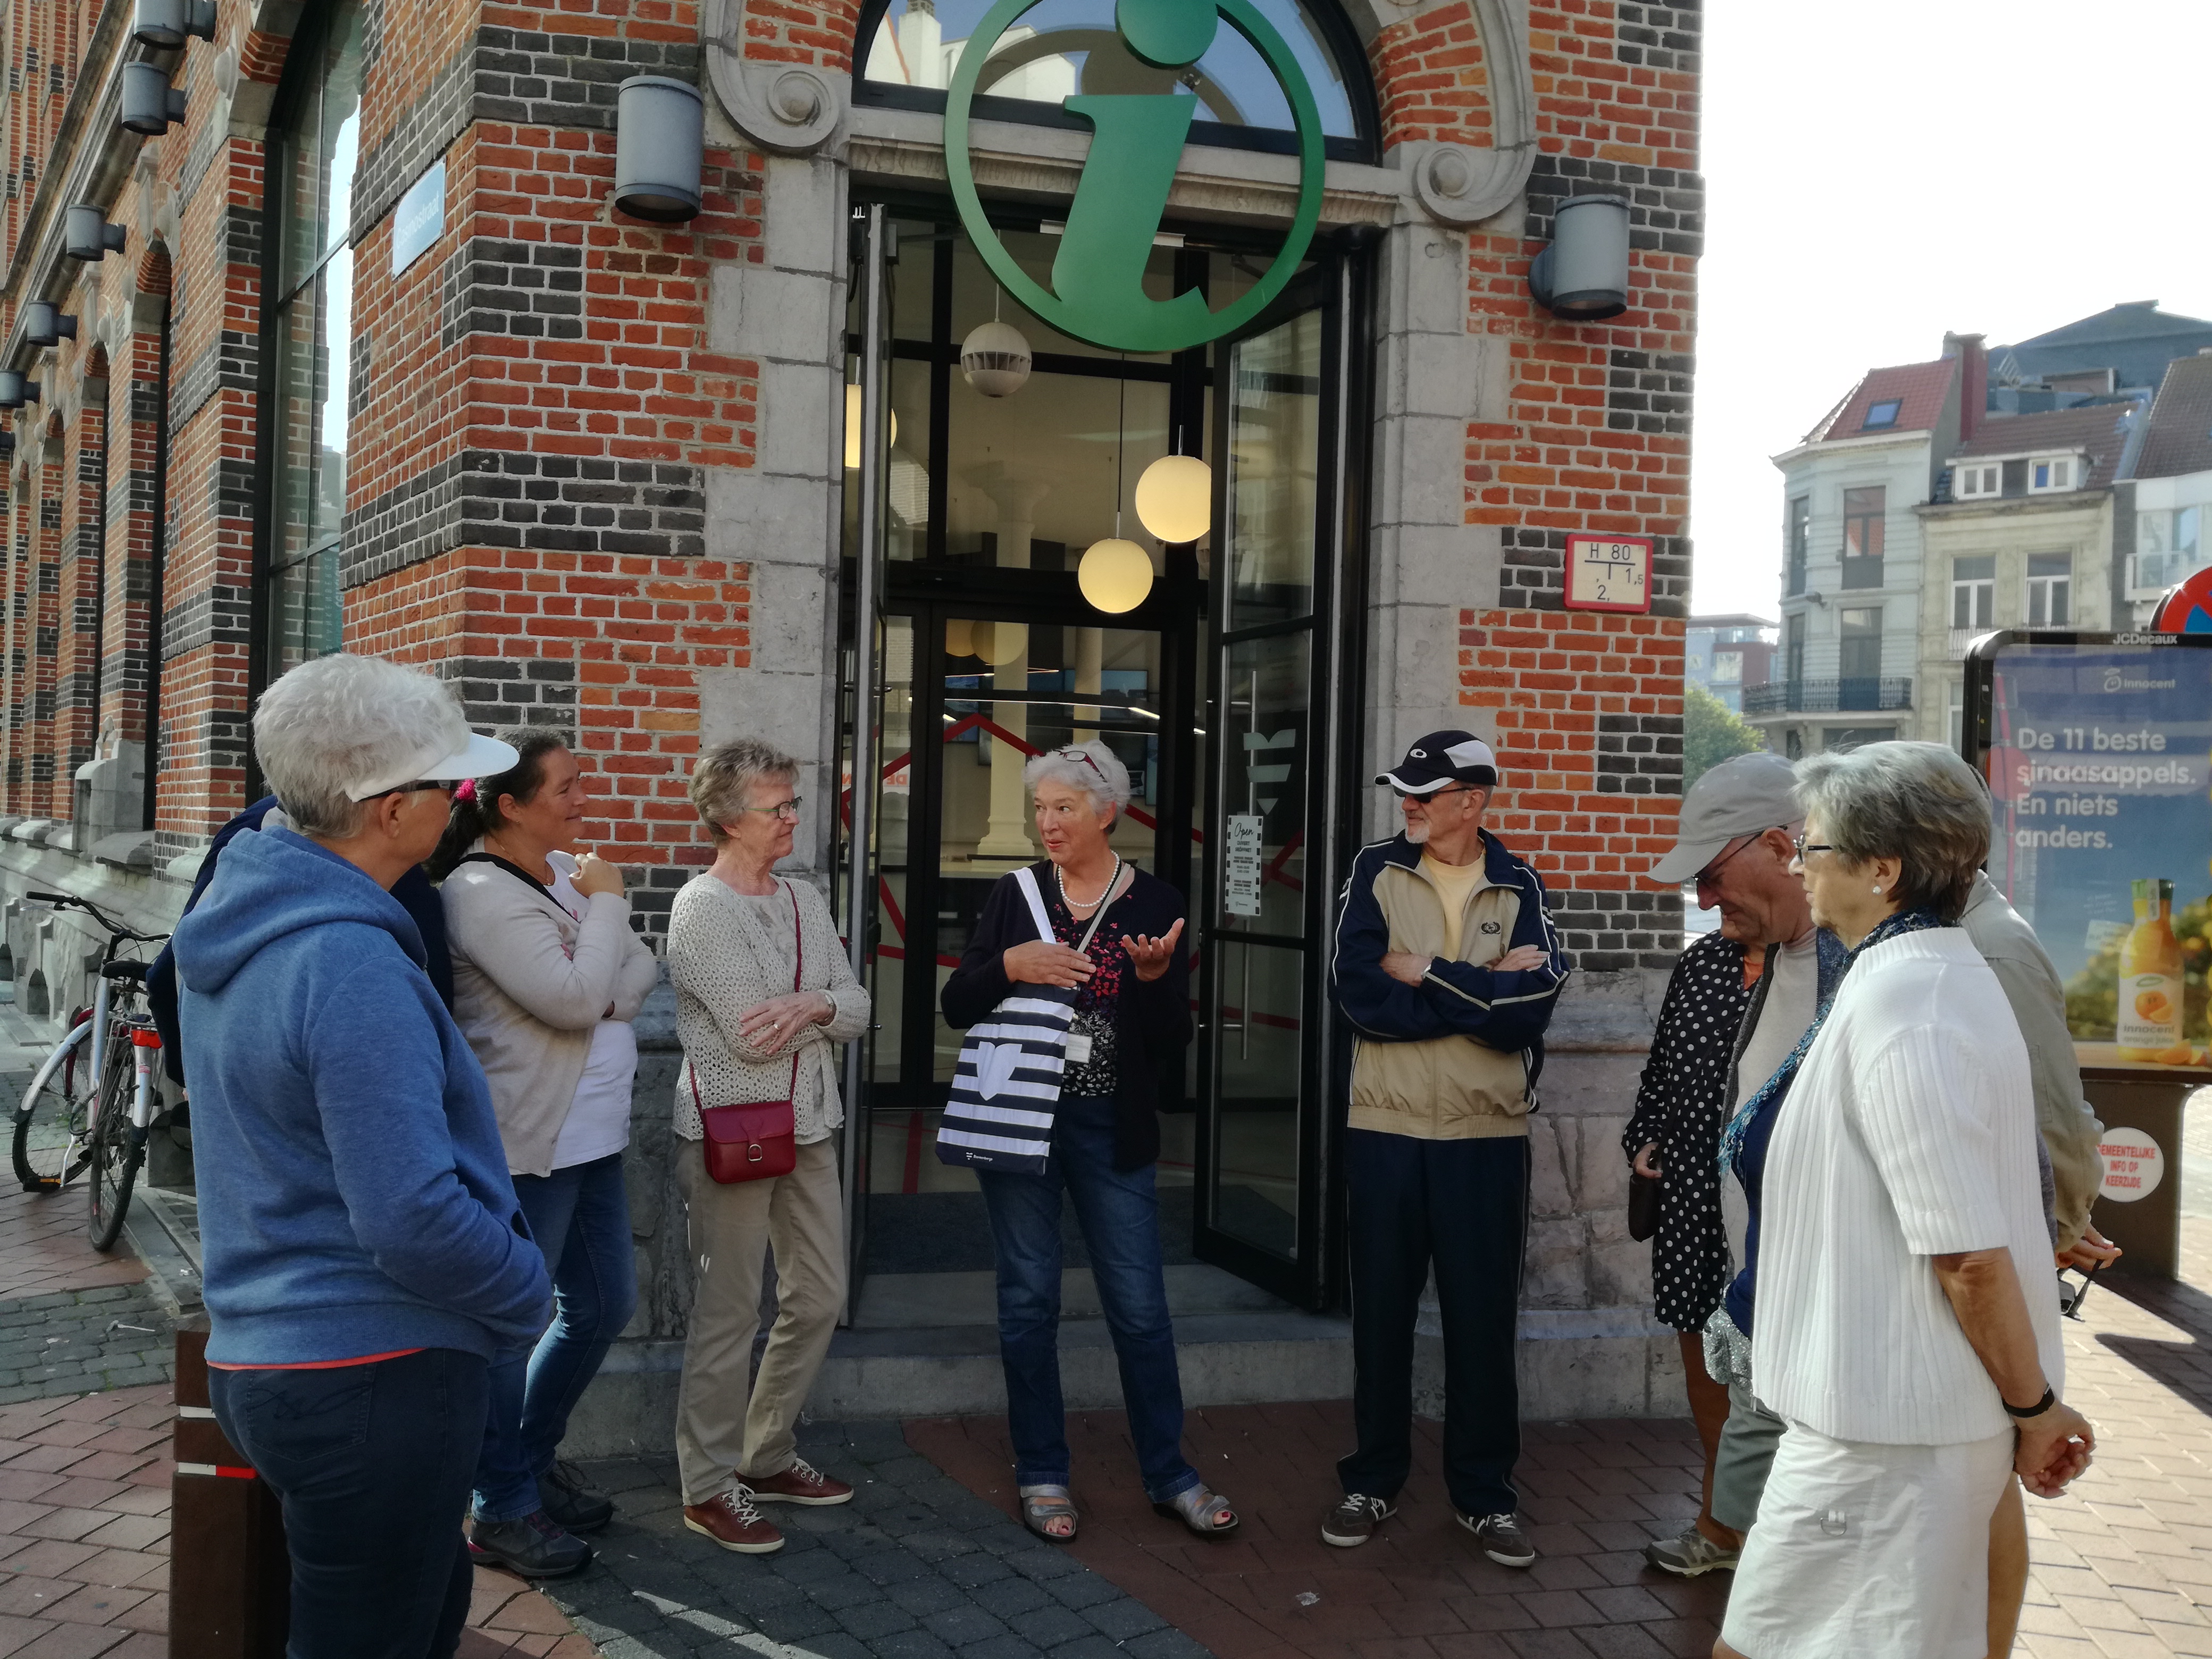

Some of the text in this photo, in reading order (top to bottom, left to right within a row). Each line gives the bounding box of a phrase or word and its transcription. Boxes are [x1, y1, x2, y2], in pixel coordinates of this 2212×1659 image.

[397, 190, 439, 249] Casinostraat
[1590, 543, 1630, 560] H 80
[2113, 633, 2178, 645] JCDecaux
[2124, 678, 2175, 689] innocent
[2018, 726, 2167, 751] De 11 beste
[2017, 759, 2197, 789] sinaasappels.
[2017, 792, 2118, 817] En niets
[1234, 822, 1254, 840] Open
[2015, 824, 2114, 849] anders.
[2124, 1025, 2175, 1034] innocent
[2109, 1160, 2139, 1173] INFO OP
[2105, 1175, 2141, 1189] KEERZIJDE
